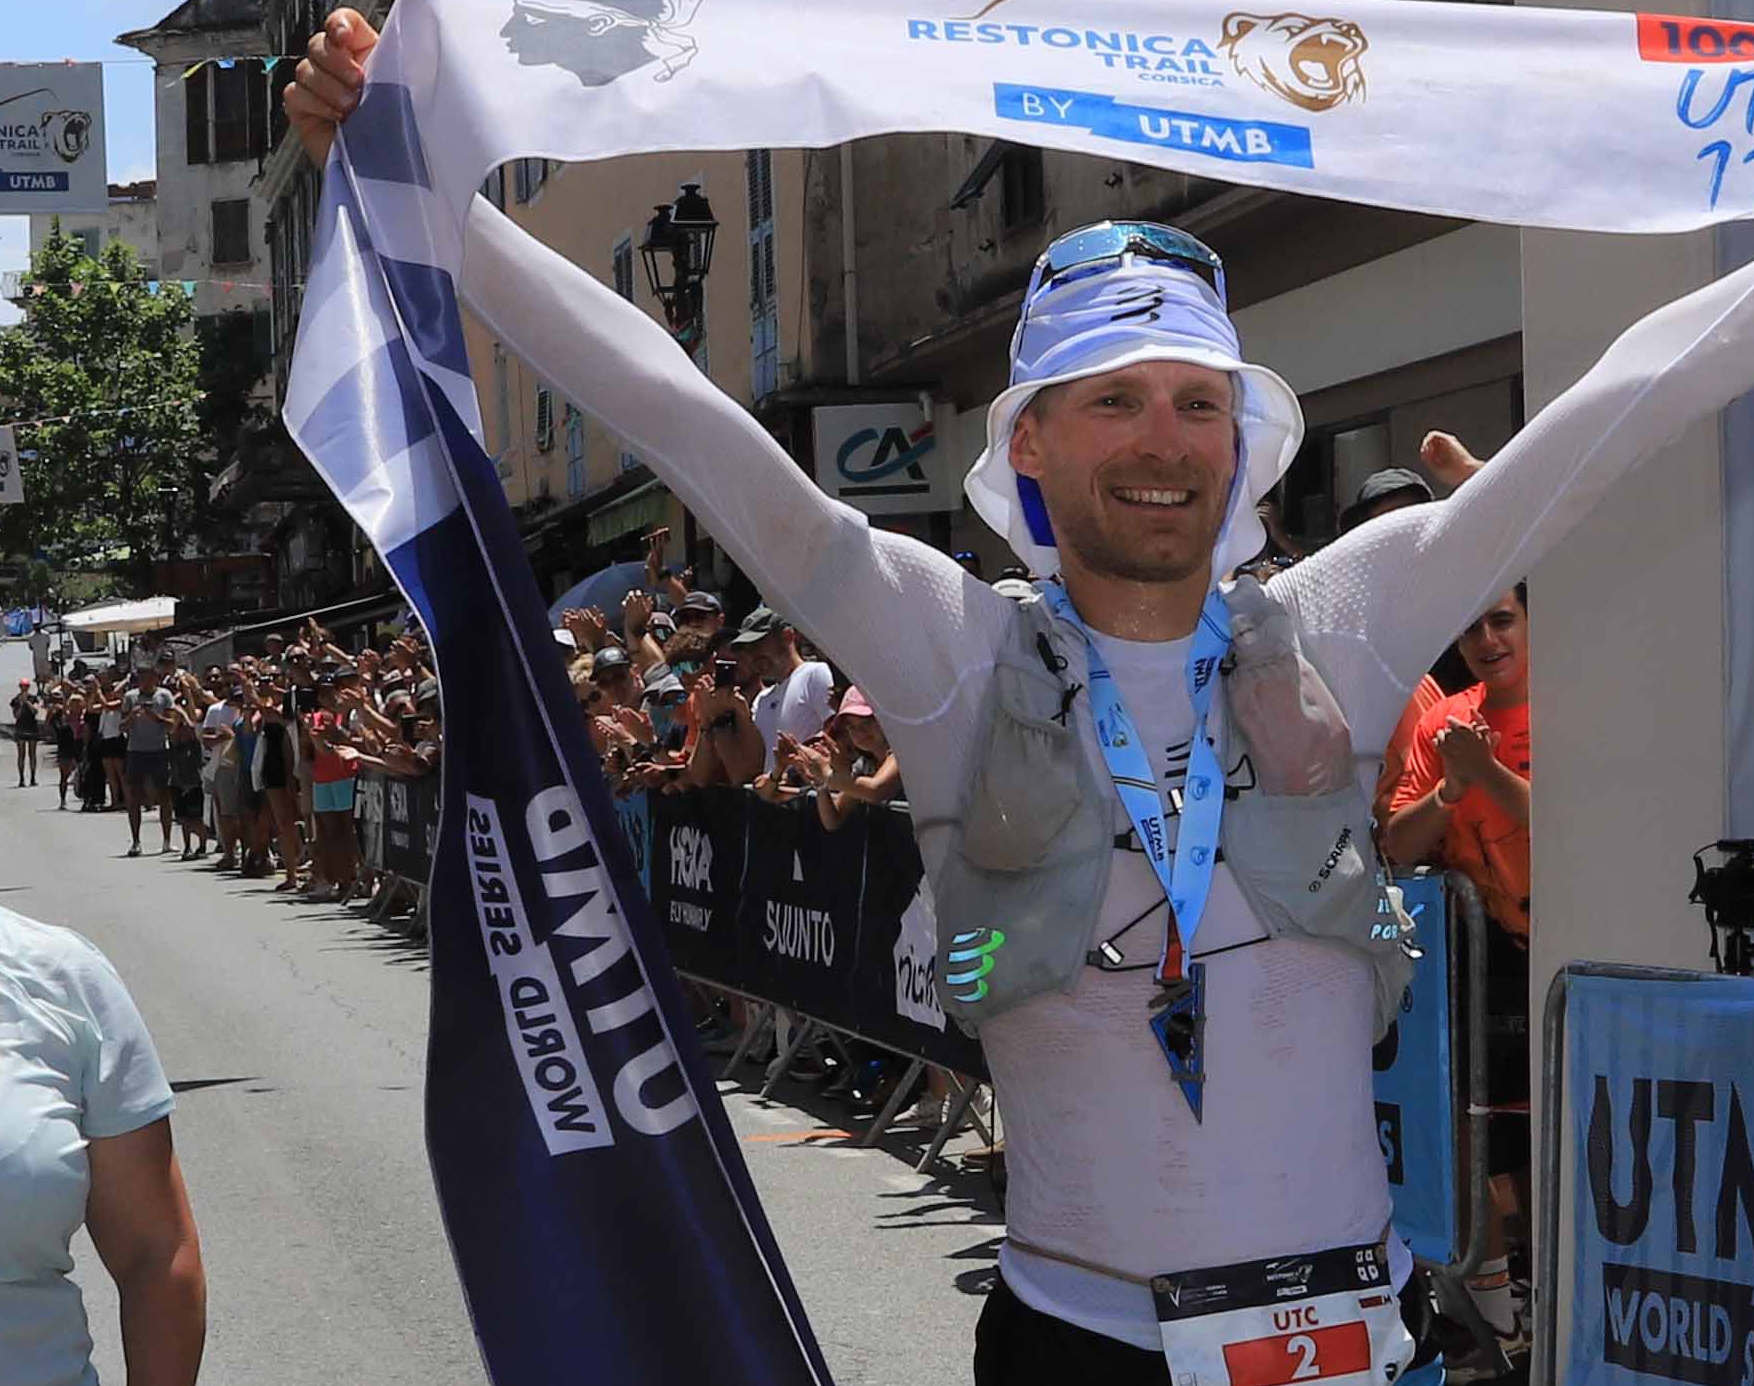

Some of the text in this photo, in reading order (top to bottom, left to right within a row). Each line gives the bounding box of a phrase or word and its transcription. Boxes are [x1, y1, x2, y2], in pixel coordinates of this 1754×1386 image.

[907, 18, 1218, 59] RESTONICA
[1094, 51, 1224, 76] TRAIL
[1138, 72, 1224, 87] CORSICA
[1022, 92, 1273, 156] BY UTMB
[10, 176, 56, 189] UTMB
[670, 825, 714, 893] HOKA
[764, 900, 836, 967] SUUNTO
[1272, 1305, 1320, 1332] UTC
[1606, 1284, 1732, 1367] WORLD
[1286, 1335, 1321, 1381] 2
